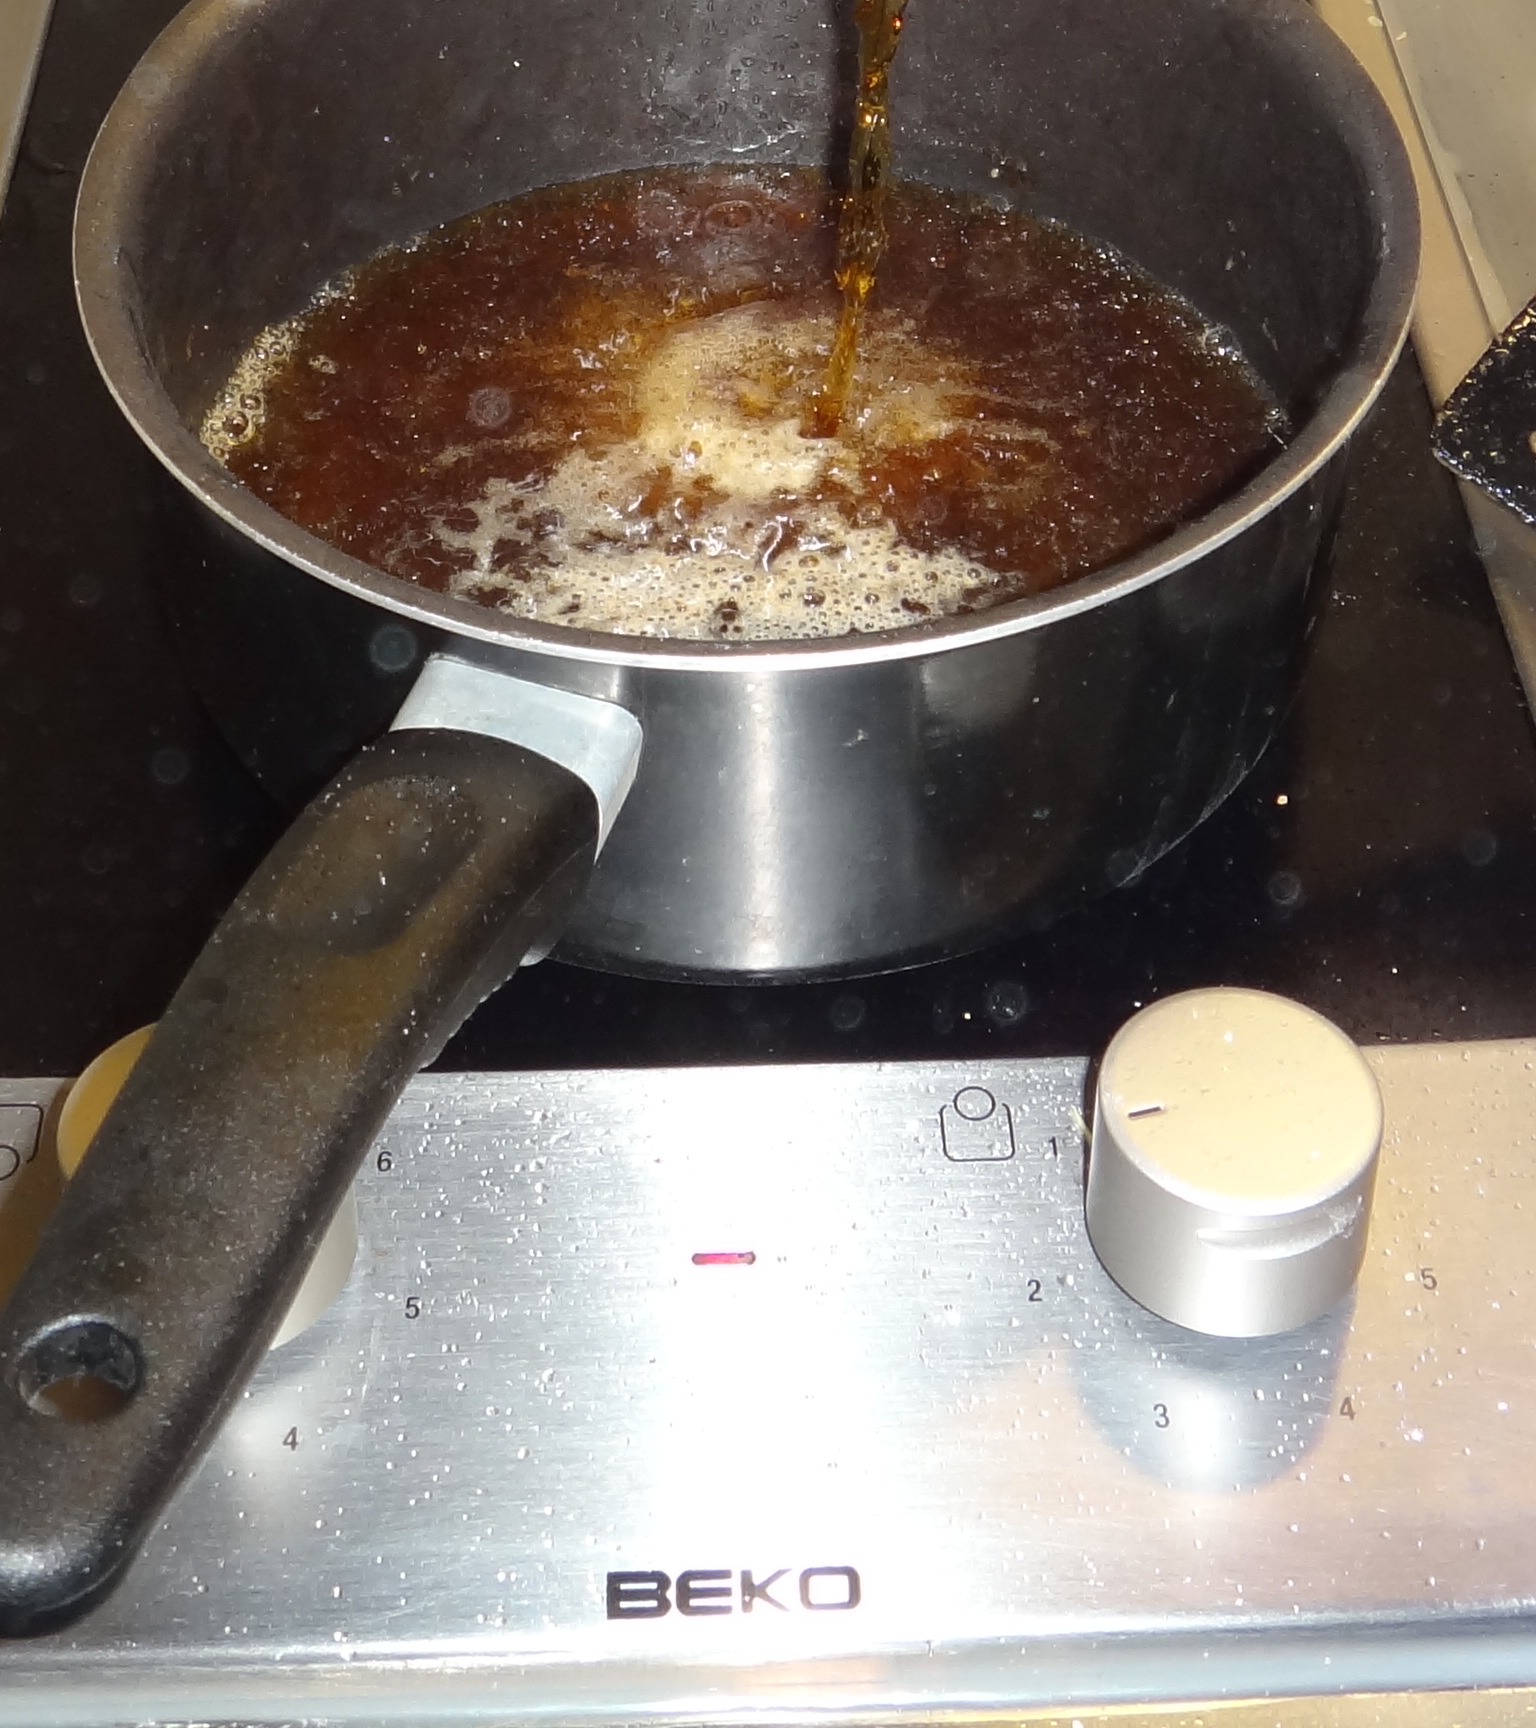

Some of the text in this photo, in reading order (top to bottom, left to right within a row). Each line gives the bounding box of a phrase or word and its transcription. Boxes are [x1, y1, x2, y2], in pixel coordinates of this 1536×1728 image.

[376, 1150, 393, 1172] 6
[1026, 1278, 1043, 1303] 2
[1420, 1267, 1438, 1291] 5
[404, 1296, 421, 1320] 5
[1152, 1402, 1171, 1429] 3
[1339, 1396, 1356, 1421] 4
[282, 1426, 299, 1452] 4
[605, 1565, 862, 1621] BEKO
